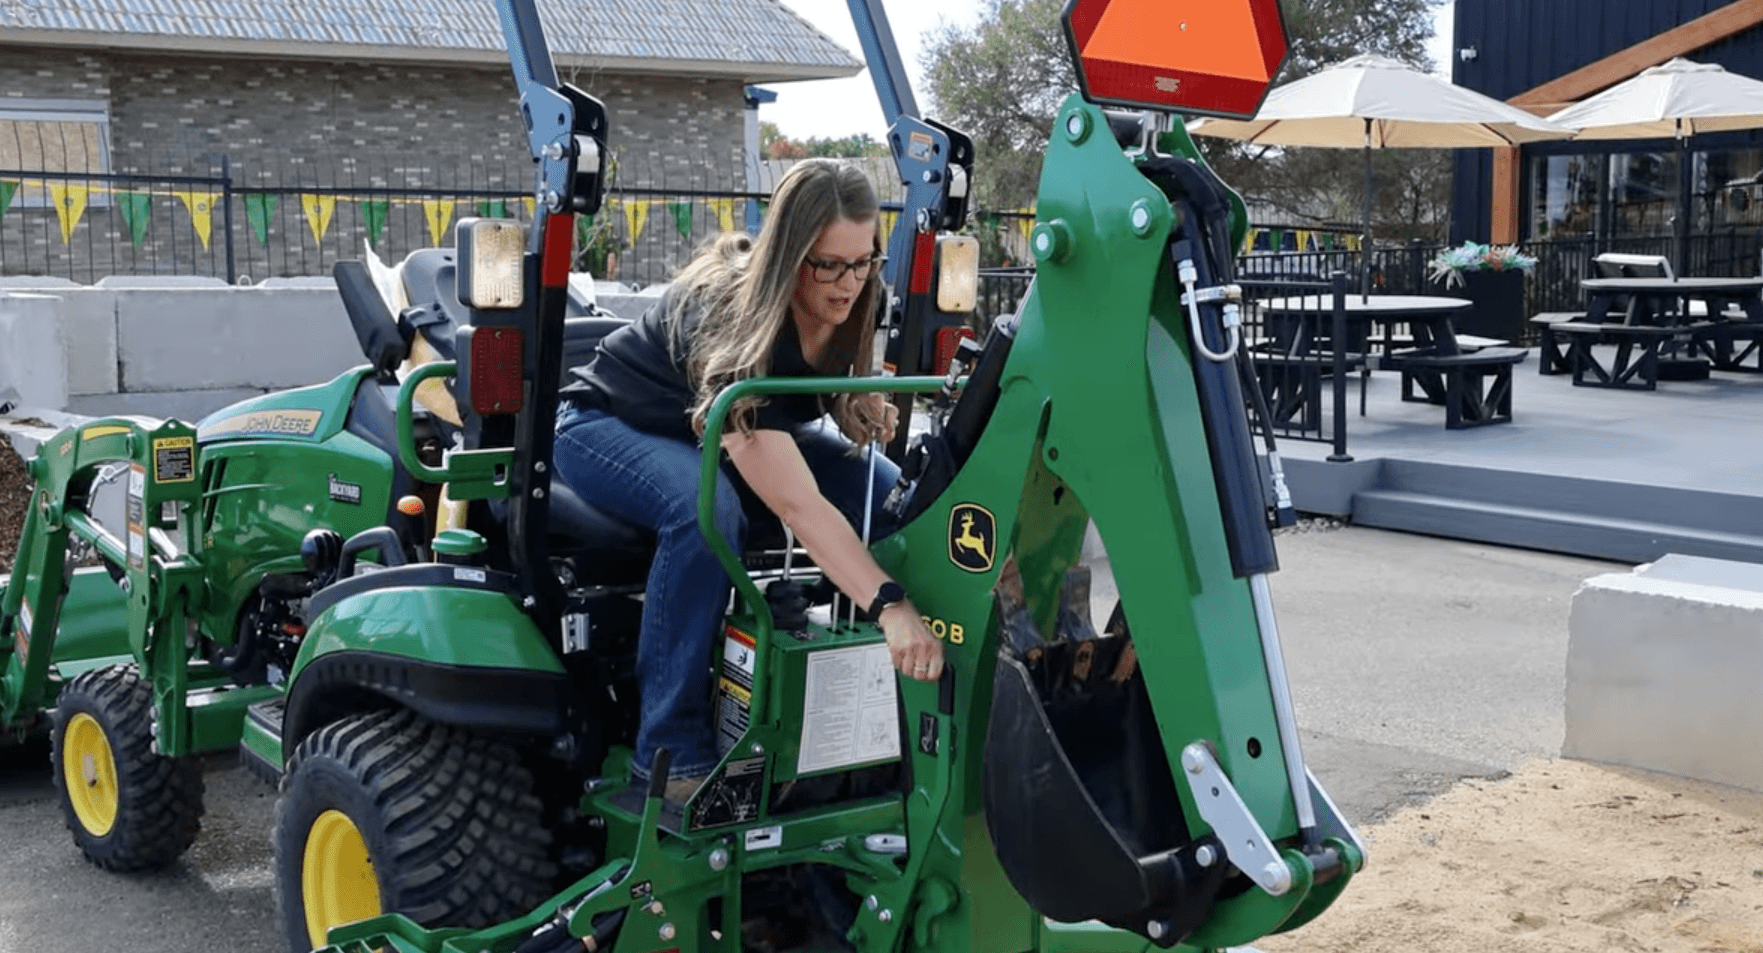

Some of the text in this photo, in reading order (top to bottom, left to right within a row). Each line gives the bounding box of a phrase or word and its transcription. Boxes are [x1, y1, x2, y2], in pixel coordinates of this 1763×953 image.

[242, 415, 311, 432] JOHN DEERE
[330, 482, 359, 499] BACKYARD
